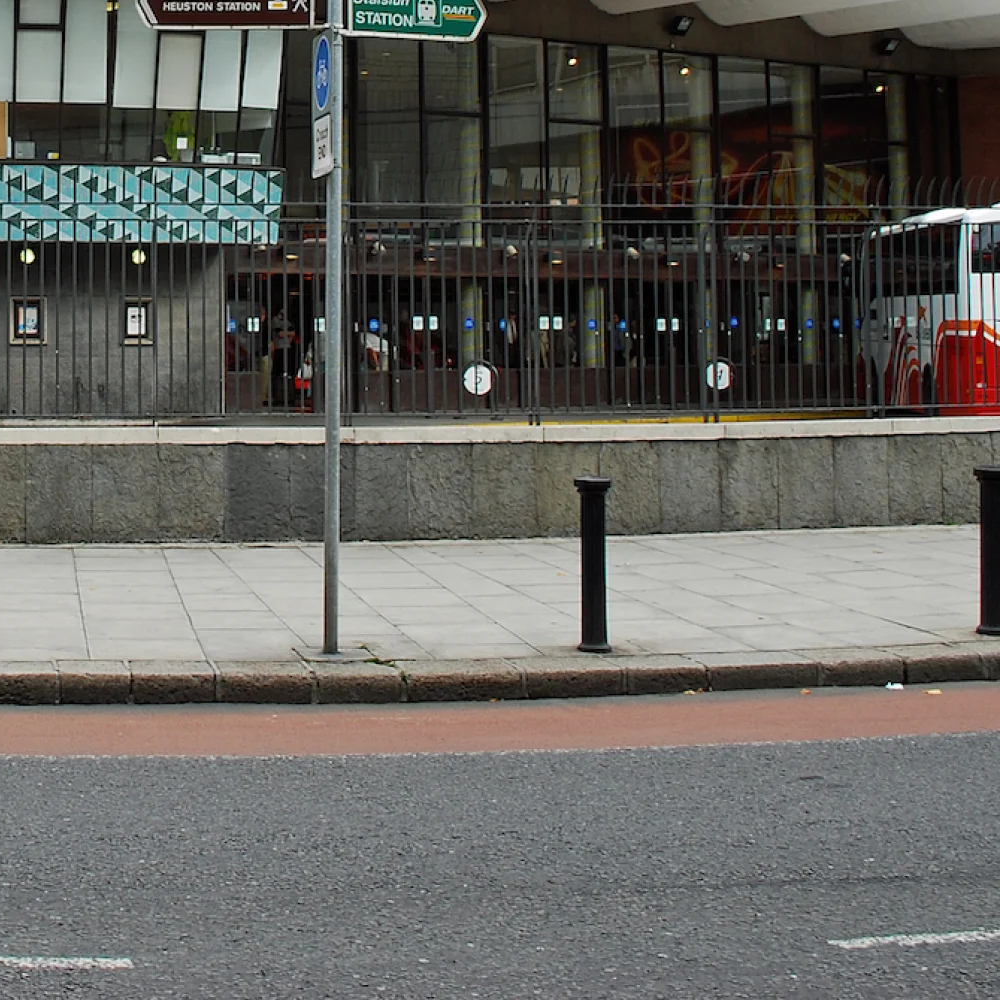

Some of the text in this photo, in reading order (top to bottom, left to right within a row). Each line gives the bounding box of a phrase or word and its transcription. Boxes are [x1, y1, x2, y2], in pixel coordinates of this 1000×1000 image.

[163, 2, 261, 12] HEUSTON STATION
[442, 5, 475, 16] DART
[355, 10, 414, 28] STATION
